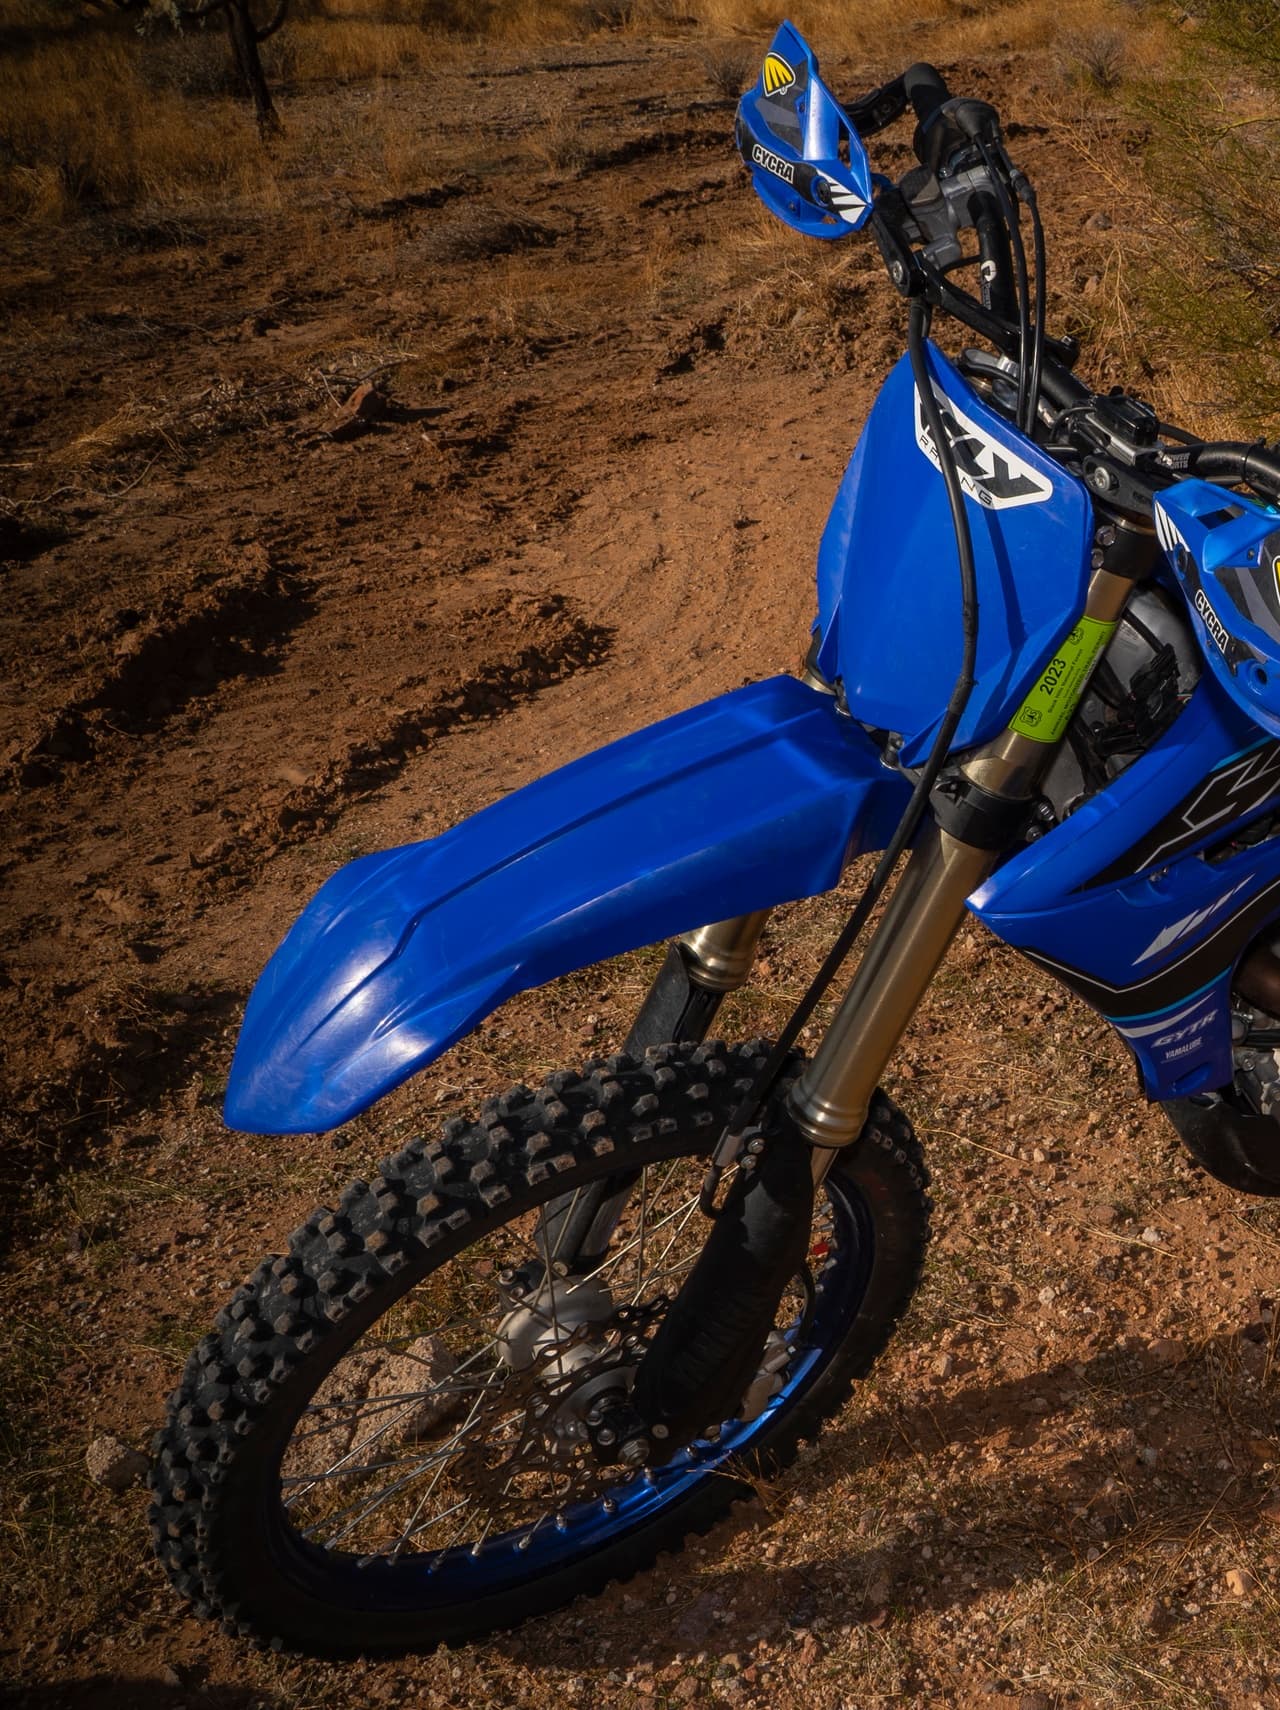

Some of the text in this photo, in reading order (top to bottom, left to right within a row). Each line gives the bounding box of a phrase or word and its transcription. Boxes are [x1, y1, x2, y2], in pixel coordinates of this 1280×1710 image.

[752, 143, 794, 184] CYCRA
[920, 435, 993, 505] RANG
[1195, 589, 1229, 655] CYCRA
[1040, 658, 1066, 696] 2023
[1151, 1009, 1218, 1048] GYTR
